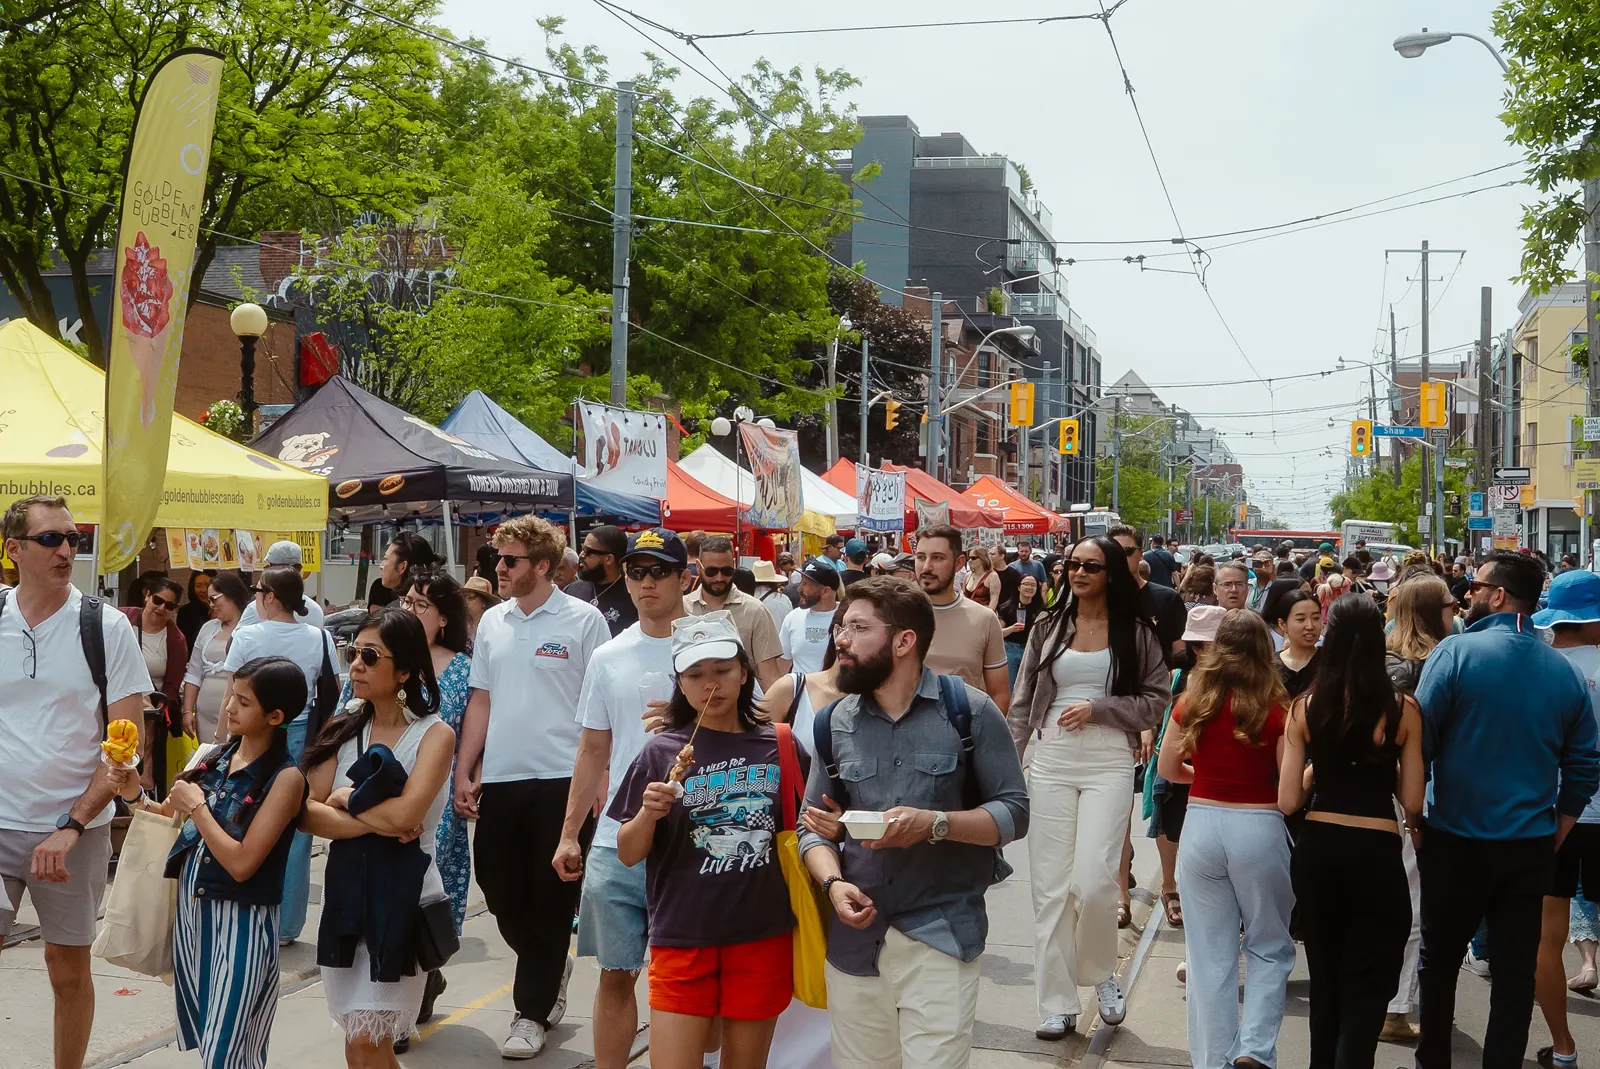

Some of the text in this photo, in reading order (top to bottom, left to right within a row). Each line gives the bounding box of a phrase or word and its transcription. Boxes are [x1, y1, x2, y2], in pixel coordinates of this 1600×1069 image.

[1384, 427, 1406, 435] Shaw
[467, 473, 559, 496] KOREAN BULGOGI ON A BUN
[632, 475, 653, 491] Candy
[266, 494, 321, 511] goldenbubbles.ca
[541, 643, 566, 656] Ford
[698, 757, 746, 775] A NEED FOR
[683, 763, 781, 807] SPEED
[699, 846, 774, 875] LIVE FAST
